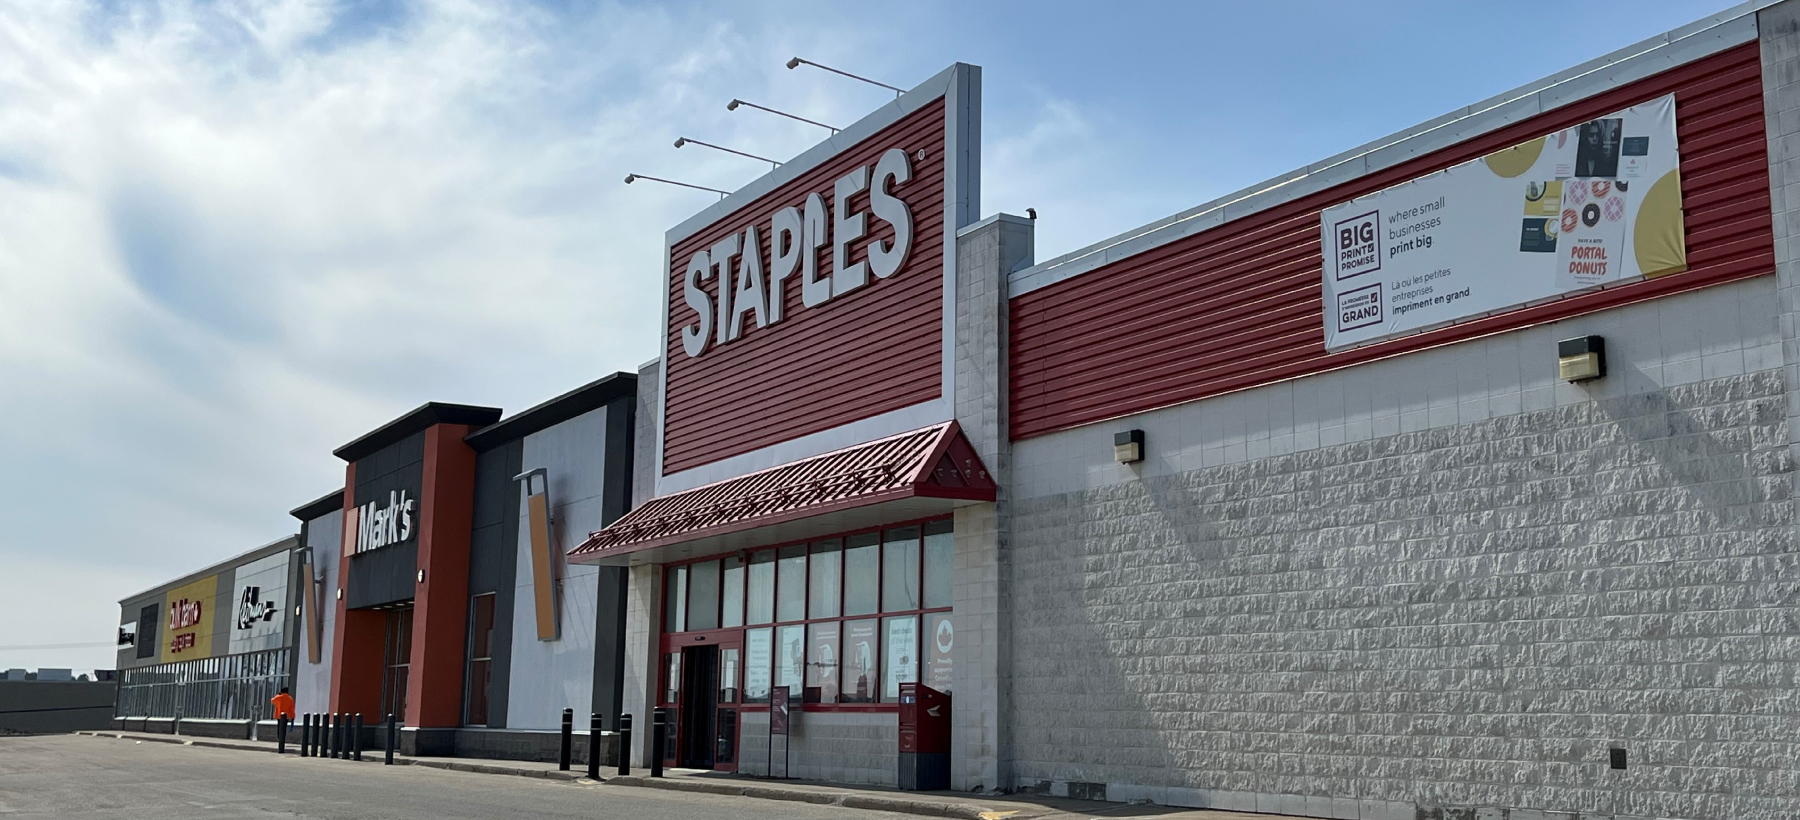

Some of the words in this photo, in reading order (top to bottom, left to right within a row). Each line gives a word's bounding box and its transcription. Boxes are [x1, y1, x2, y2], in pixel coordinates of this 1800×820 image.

[1388, 206, 1418, 225] where
[1419, 196, 1445, 215] small
[1340, 221, 1374, 250] BIG
[1389, 216, 1441, 240] businesses
[682, 148, 913, 358] STAPLES
[1341, 245, 1367, 262] PRINT
[1390, 240, 1414, 258] print
[1571, 245, 1608, 260] PORTAL
[1341, 254, 1375, 271] PROMISE
[1568, 261, 1608, 275] DONUTS
[1412, 273, 1423, 285] les
[1424, 268, 1451, 284] petites
[1392, 284, 1434, 303] entreprises
[1342, 305, 1379, 323] GRAND
[1392, 298, 1433, 316] impriment
[1434, 296, 1445, 305] en
[357, 489, 415, 554] Mark's
